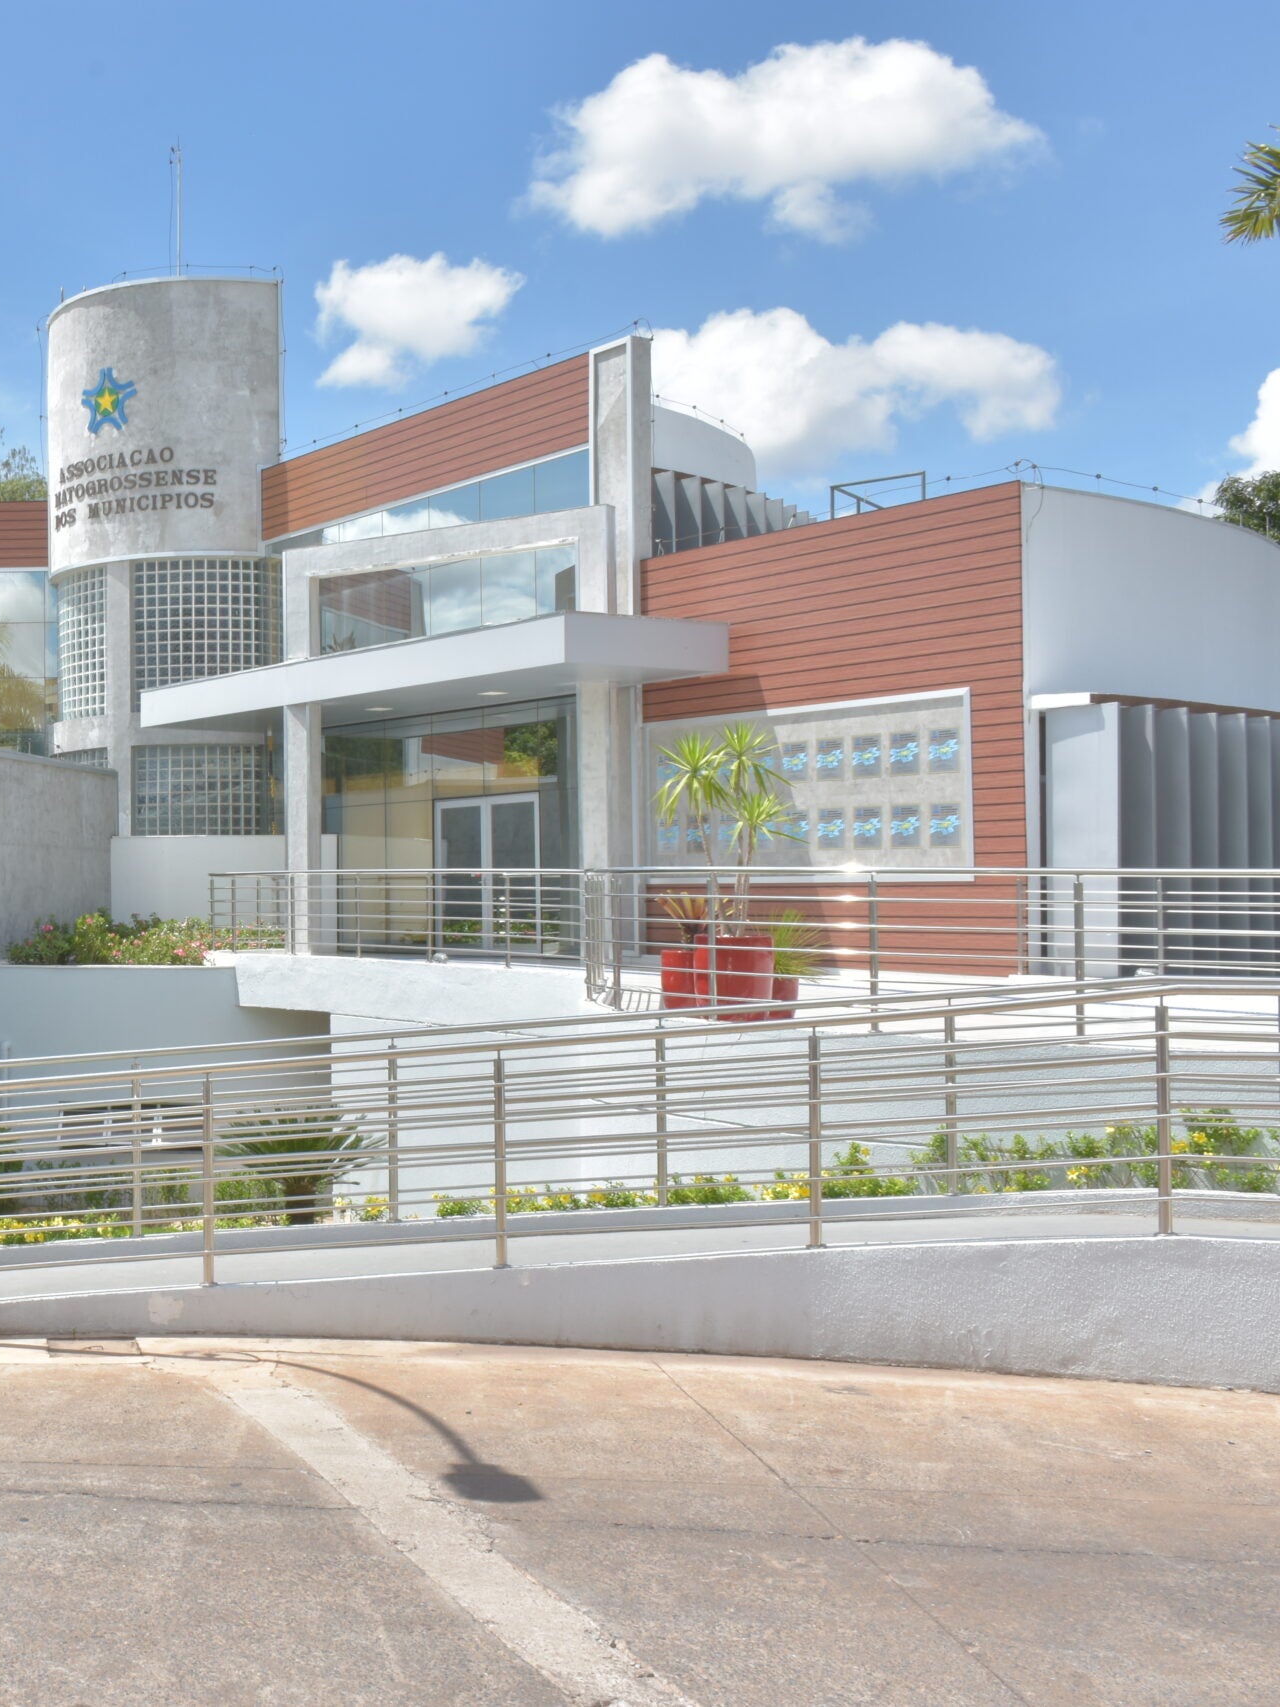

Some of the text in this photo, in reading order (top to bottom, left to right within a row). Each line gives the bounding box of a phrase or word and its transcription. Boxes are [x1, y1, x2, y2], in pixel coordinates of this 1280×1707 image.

[55, 469, 217, 508] MATOGROSSENSE
[55, 492, 215, 531] DOS MUNICIPIOS
